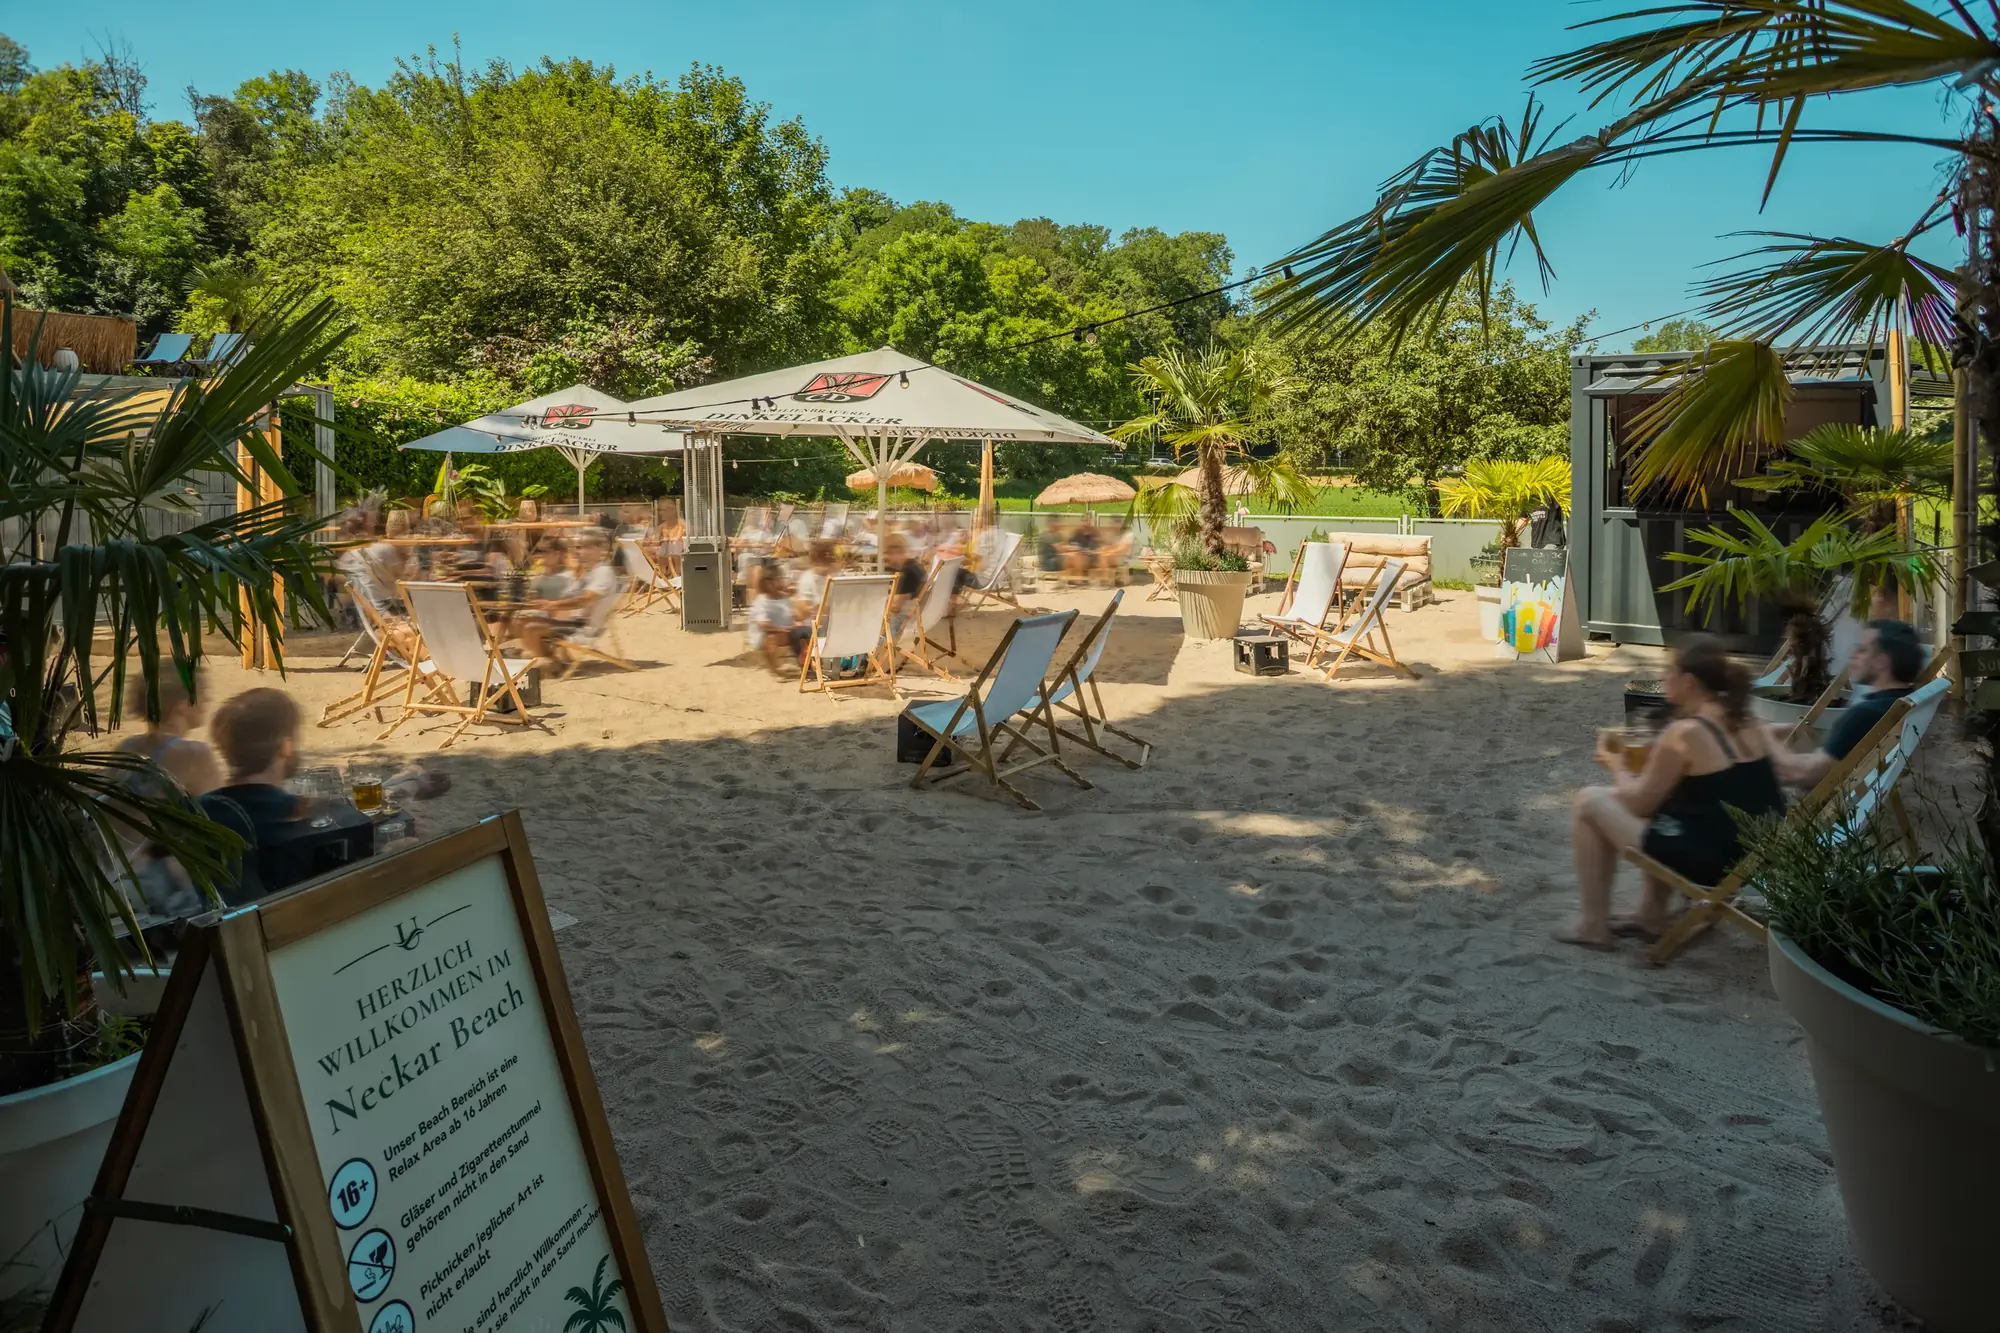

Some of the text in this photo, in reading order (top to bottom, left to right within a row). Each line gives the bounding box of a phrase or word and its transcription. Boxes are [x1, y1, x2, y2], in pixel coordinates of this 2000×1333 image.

[494, 437, 618, 451] DINKELACKER
[705, 413, 903, 425] DINKELACKER
[1977, 656, 2000, 672] So
[317, 948, 512, 1076] WILLKOMMEN IM
[356, 939, 473, 1021] HERZLICH
[325, 980, 525, 1135] Neckar Beach
[383, 1054, 518, 1162] Unser Beach Bereich ist eine
[388, 1084, 508, 1182] Relax Area ab 16 Jahren
[337, 1179, 369, 1213] 16+
[400, 1100, 542, 1228] Gläser und Zigarettenstummel
[406, 1131, 530, 1253] gehören nicht in den Sand
[420, 1173, 545, 1300] Picknicken jeglicher Art ist
[426, 1249, 491, 1320] nicht erlaubt
[476, 1296, 497, 1327] sind
[497, 1260, 533, 1303] herzlich
[532, 1208, 583, 1263] Willkommen
[495, 1312, 509, 1331] sie
[509, 1286, 531, 1315] nicht
[532, 1275, 540, 1290] in
[541, 1257, 557, 1278] den
[556, 1231, 576, 1260] Sand
